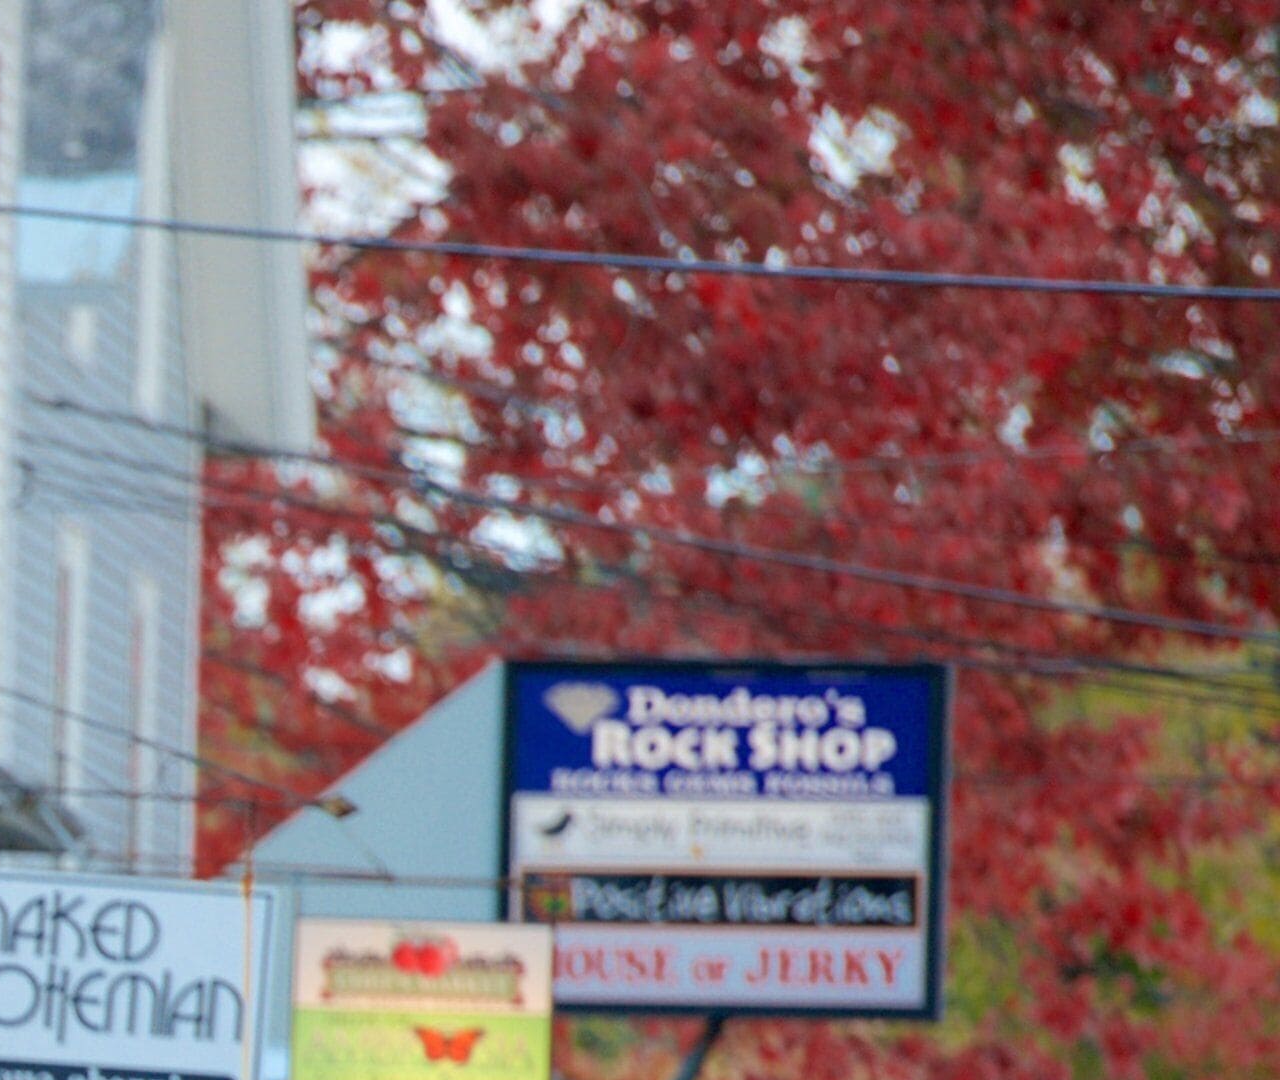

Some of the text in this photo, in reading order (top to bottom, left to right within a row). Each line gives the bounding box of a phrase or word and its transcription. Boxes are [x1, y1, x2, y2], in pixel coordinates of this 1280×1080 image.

[626, 684, 867, 729] Dondero's
[591, 718, 897, 772] ROCK SHOP
[745, 947, 904, 985] JERKY
